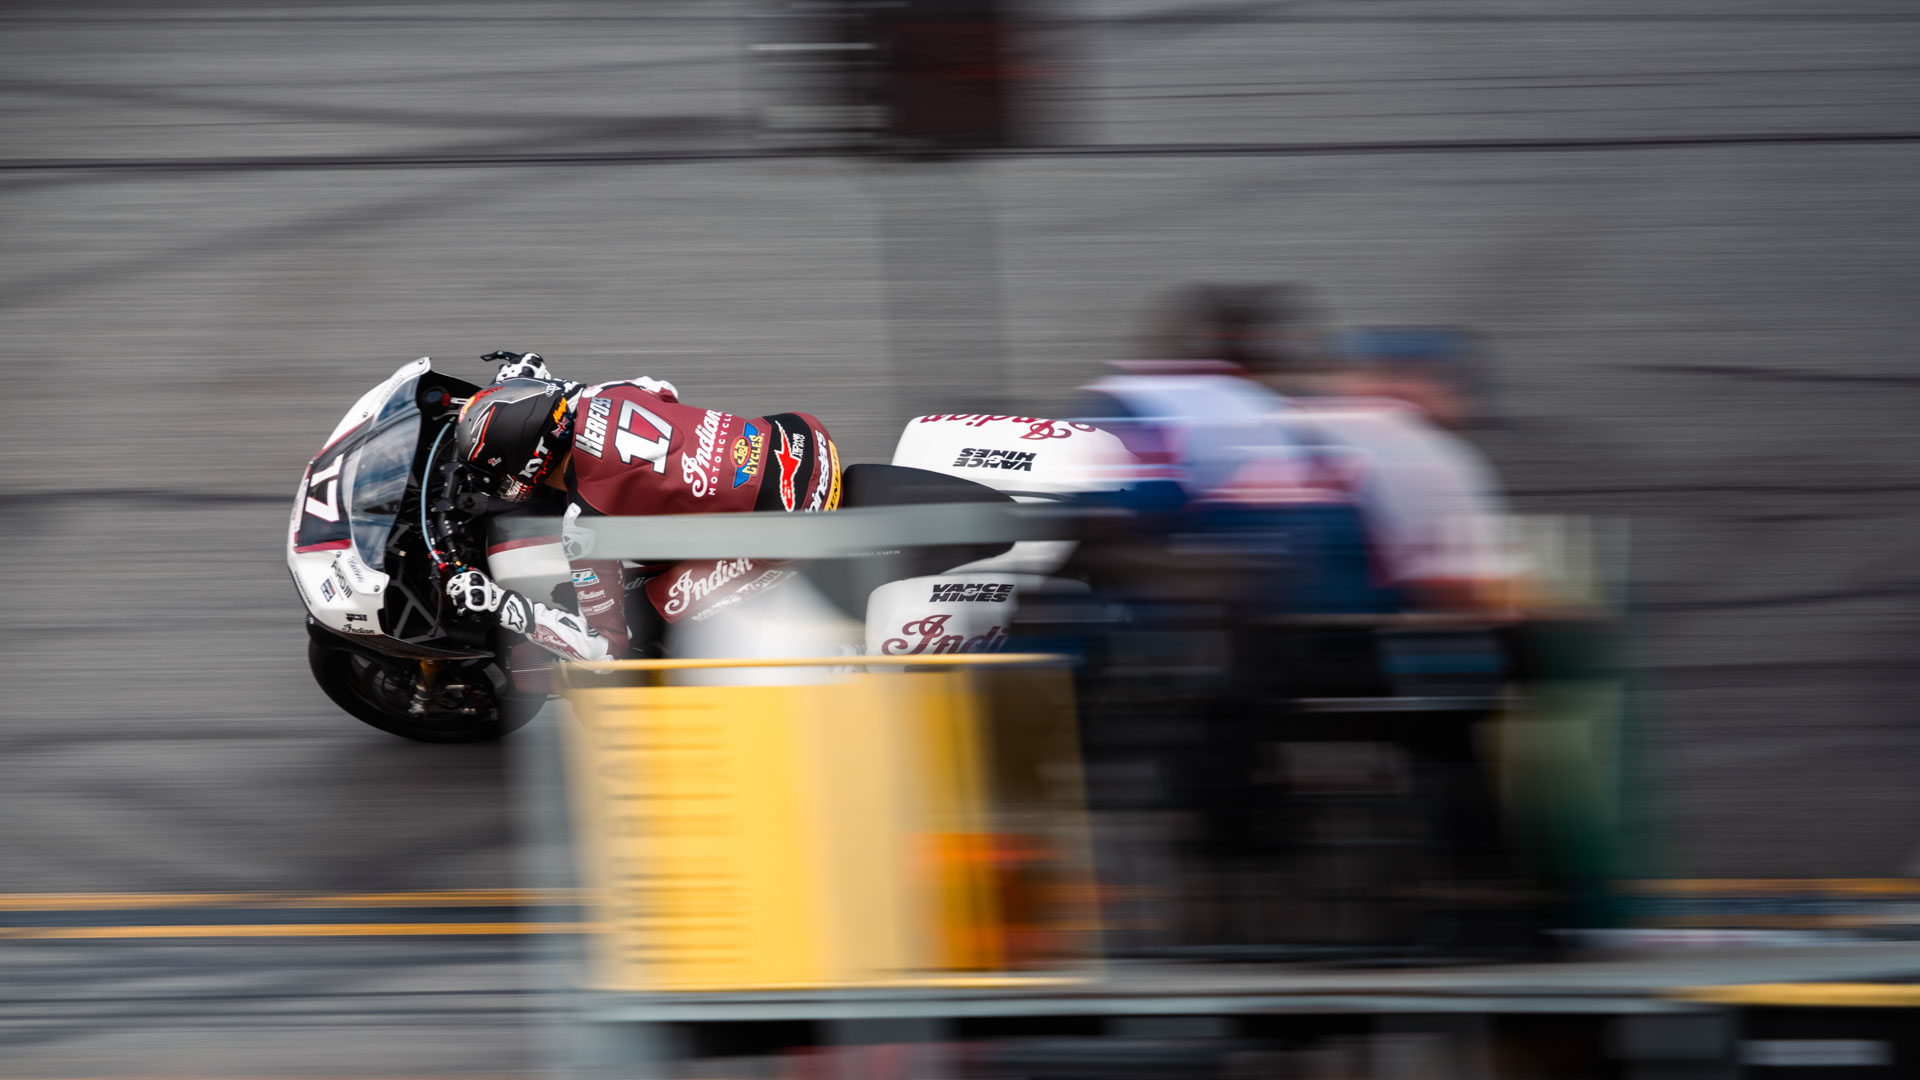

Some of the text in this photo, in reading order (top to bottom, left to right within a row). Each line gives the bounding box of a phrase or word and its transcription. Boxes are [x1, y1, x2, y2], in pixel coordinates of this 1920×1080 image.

[519, 436, 550, 479] KYT
[614, 399, 674, 476] 17
[681, 409, 722, 498] Indian
[742, 434, 764, 476] CYCLES
[960, 447, 1037, 462] HINES
[952, 457, 1033, 472] VANCE
[304, 453, 345, 522] 17
[928, 592, 1009, 603] HINES
[932, 583, 1015, 593] VANCE
[342, 623, 375, 634] Indian
[881, 614, 1010, 655] Indi
